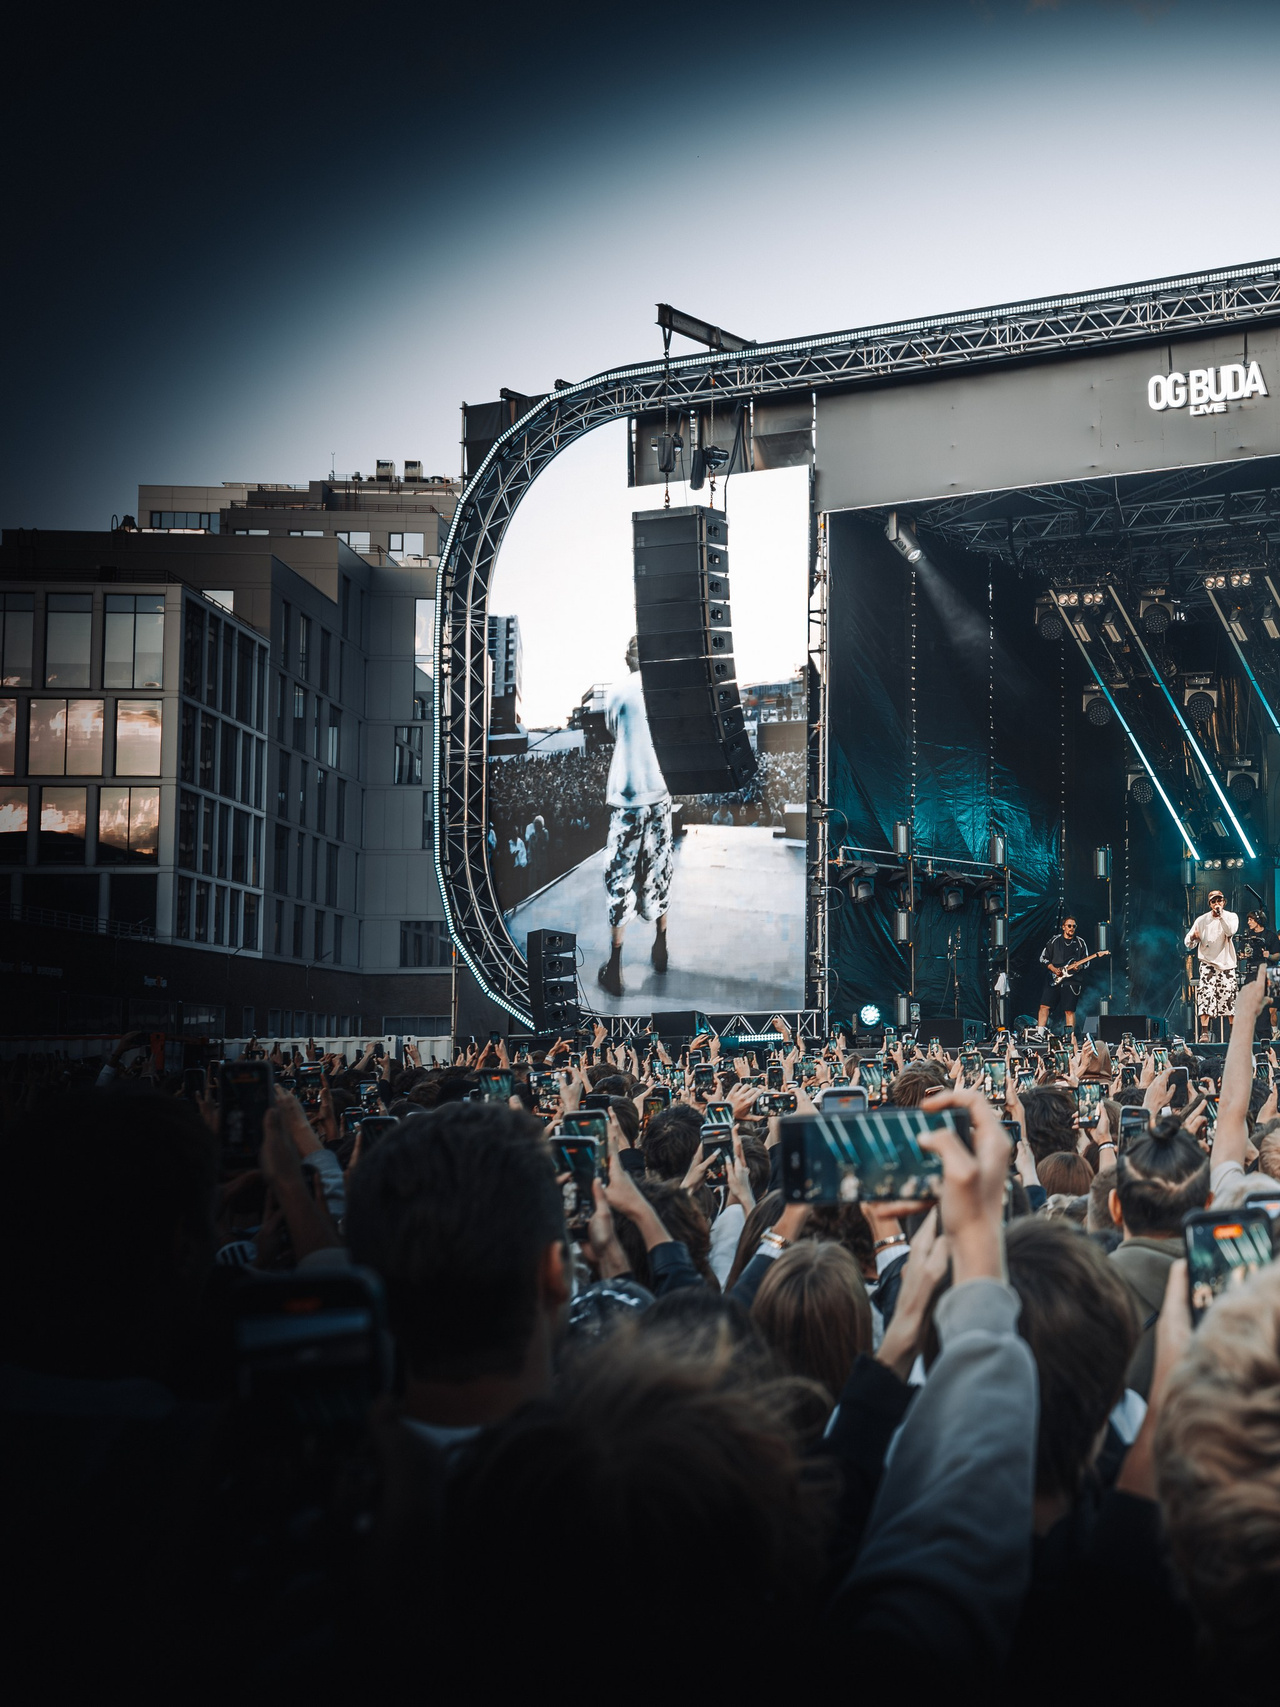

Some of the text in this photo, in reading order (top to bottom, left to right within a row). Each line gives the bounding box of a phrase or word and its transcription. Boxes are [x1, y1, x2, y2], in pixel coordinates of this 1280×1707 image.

[1147, 360, 1269, 411] OG BUDA
[1189, 402, 1227, 416] LIVE
